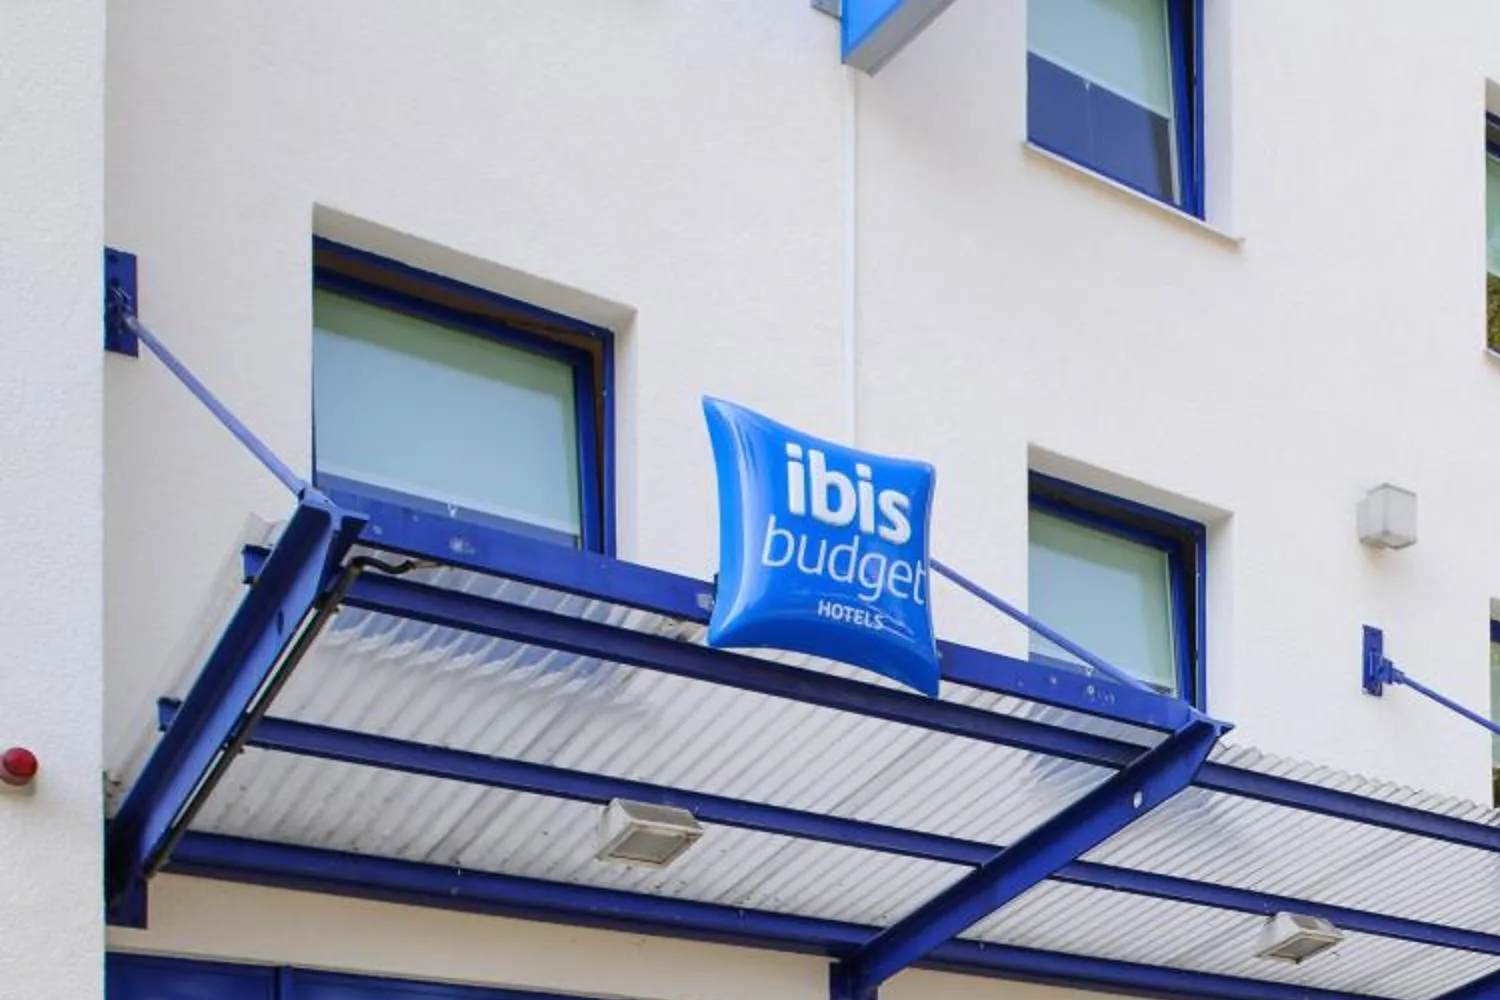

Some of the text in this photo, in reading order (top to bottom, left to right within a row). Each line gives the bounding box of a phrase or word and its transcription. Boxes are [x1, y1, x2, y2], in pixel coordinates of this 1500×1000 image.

[785, 442, 912, 545] ibis
[761, 514, 926, 605] budget
[818, 599, 884, 629] HOTELS
